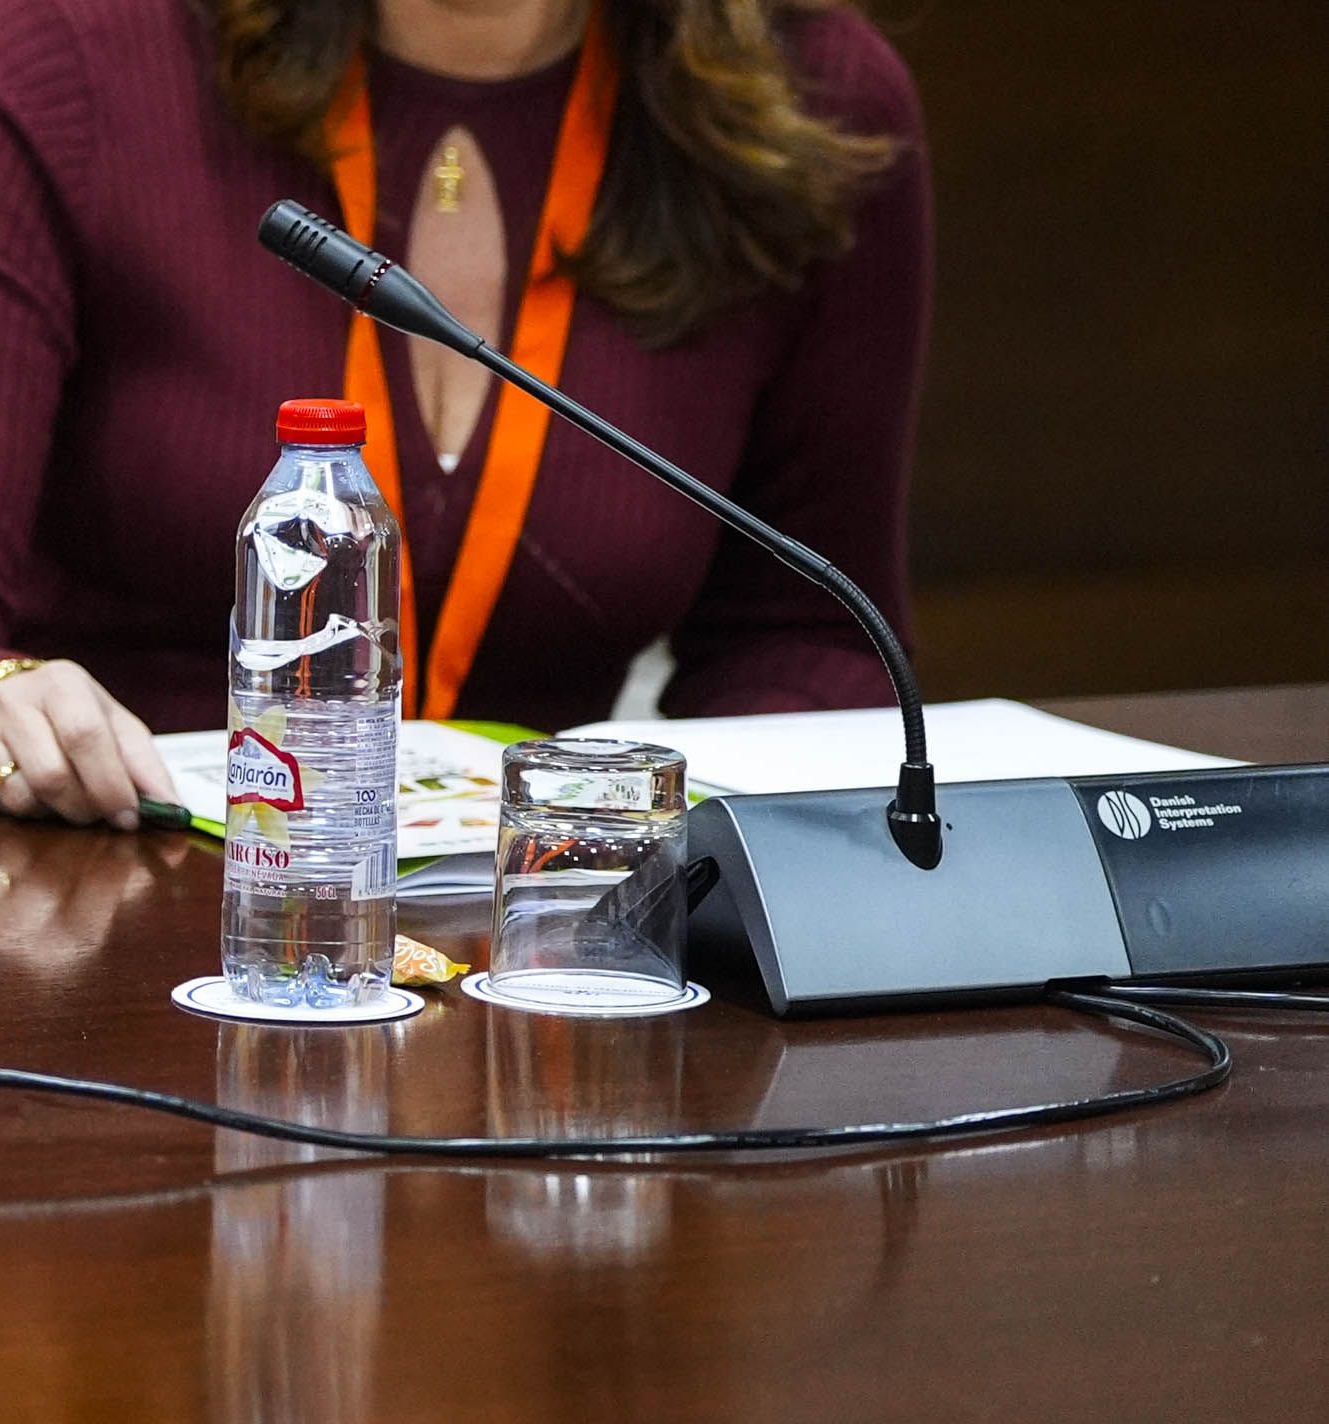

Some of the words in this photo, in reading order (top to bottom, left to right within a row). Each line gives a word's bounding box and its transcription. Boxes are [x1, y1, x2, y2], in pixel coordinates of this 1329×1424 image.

[1149, 795, 1196, 807] Danish
[1154, 804, 1242, 818] Interpretation
[1159, 818, 1215, 831] Systems
[228, 841, 290, 869] ARCISO
